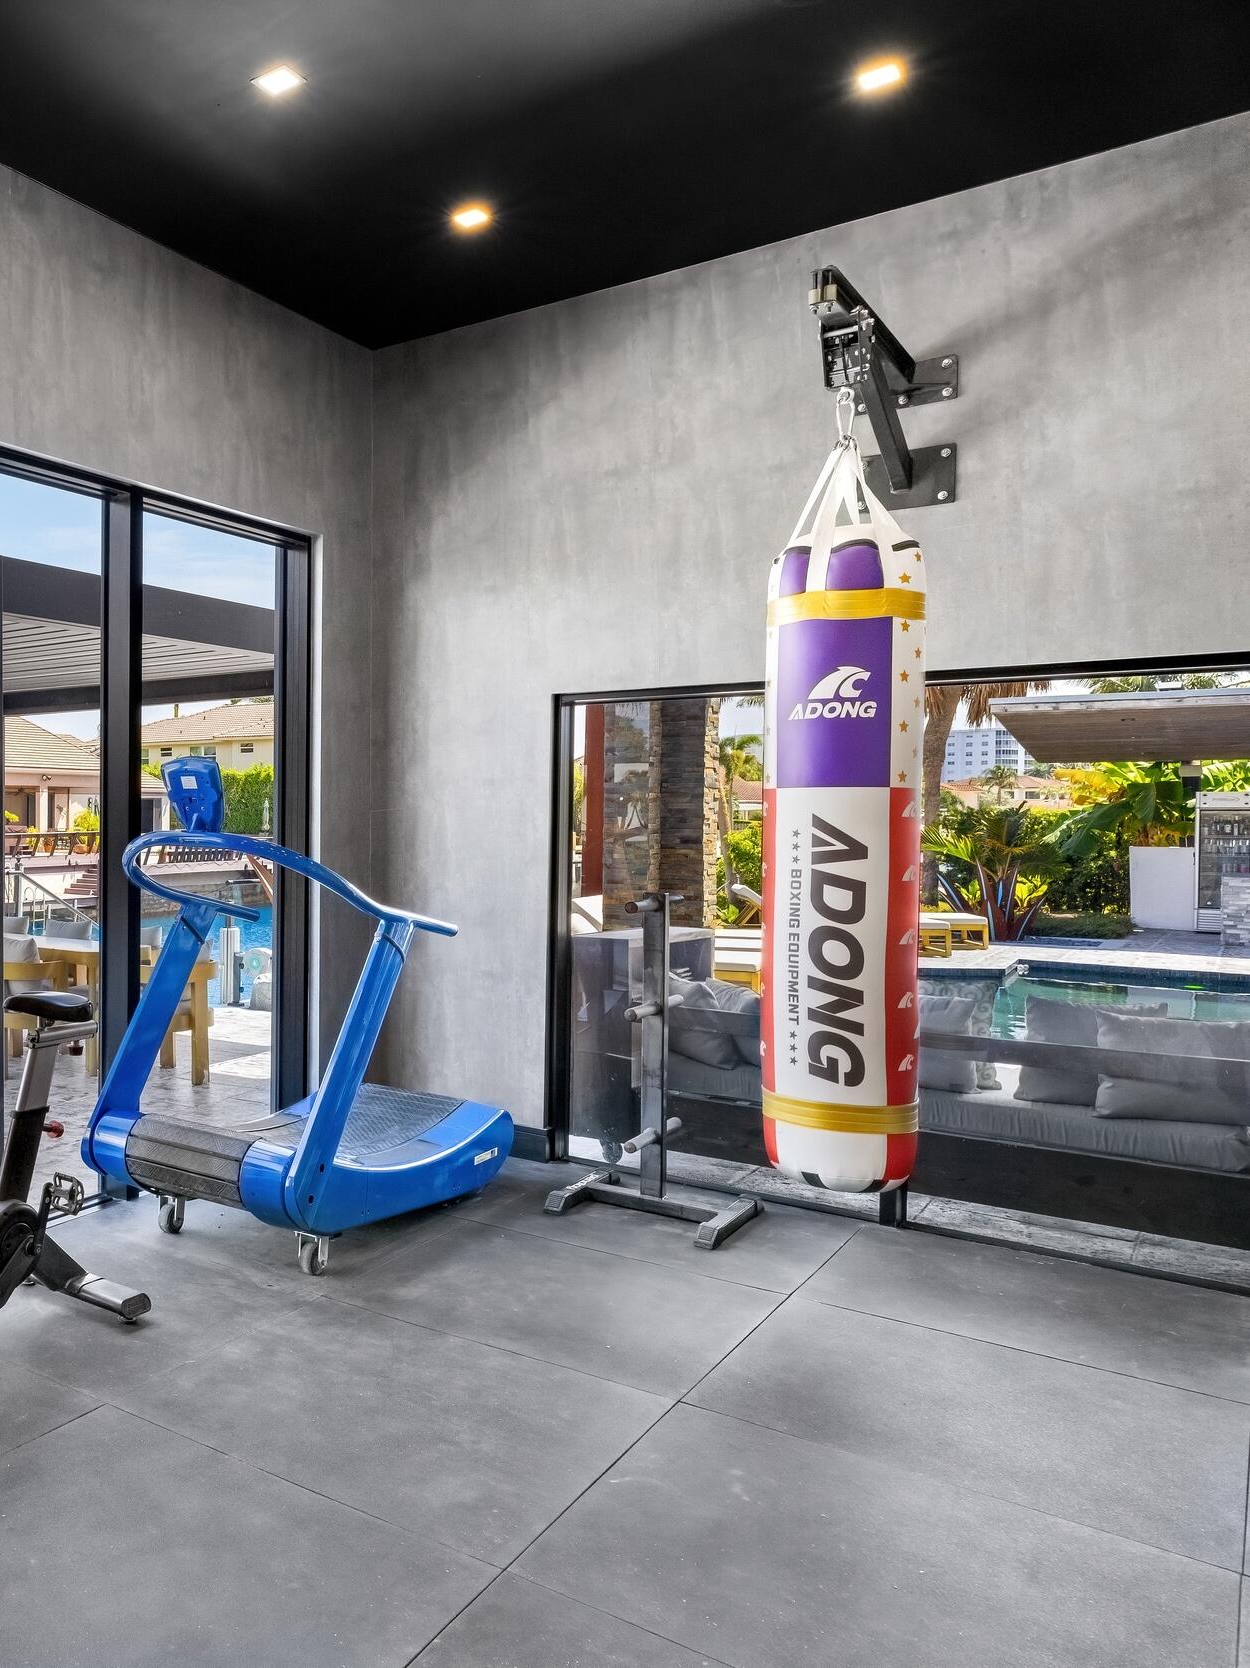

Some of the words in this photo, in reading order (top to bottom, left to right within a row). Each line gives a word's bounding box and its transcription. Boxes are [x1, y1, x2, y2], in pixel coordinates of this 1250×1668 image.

[788, 701, 878, 720] ADONG
[789, 868, 802, 928] BOXING
[787, 932, 800, 1026] EQUIPMENT
[806, 813, 868, 1088] ADONG
